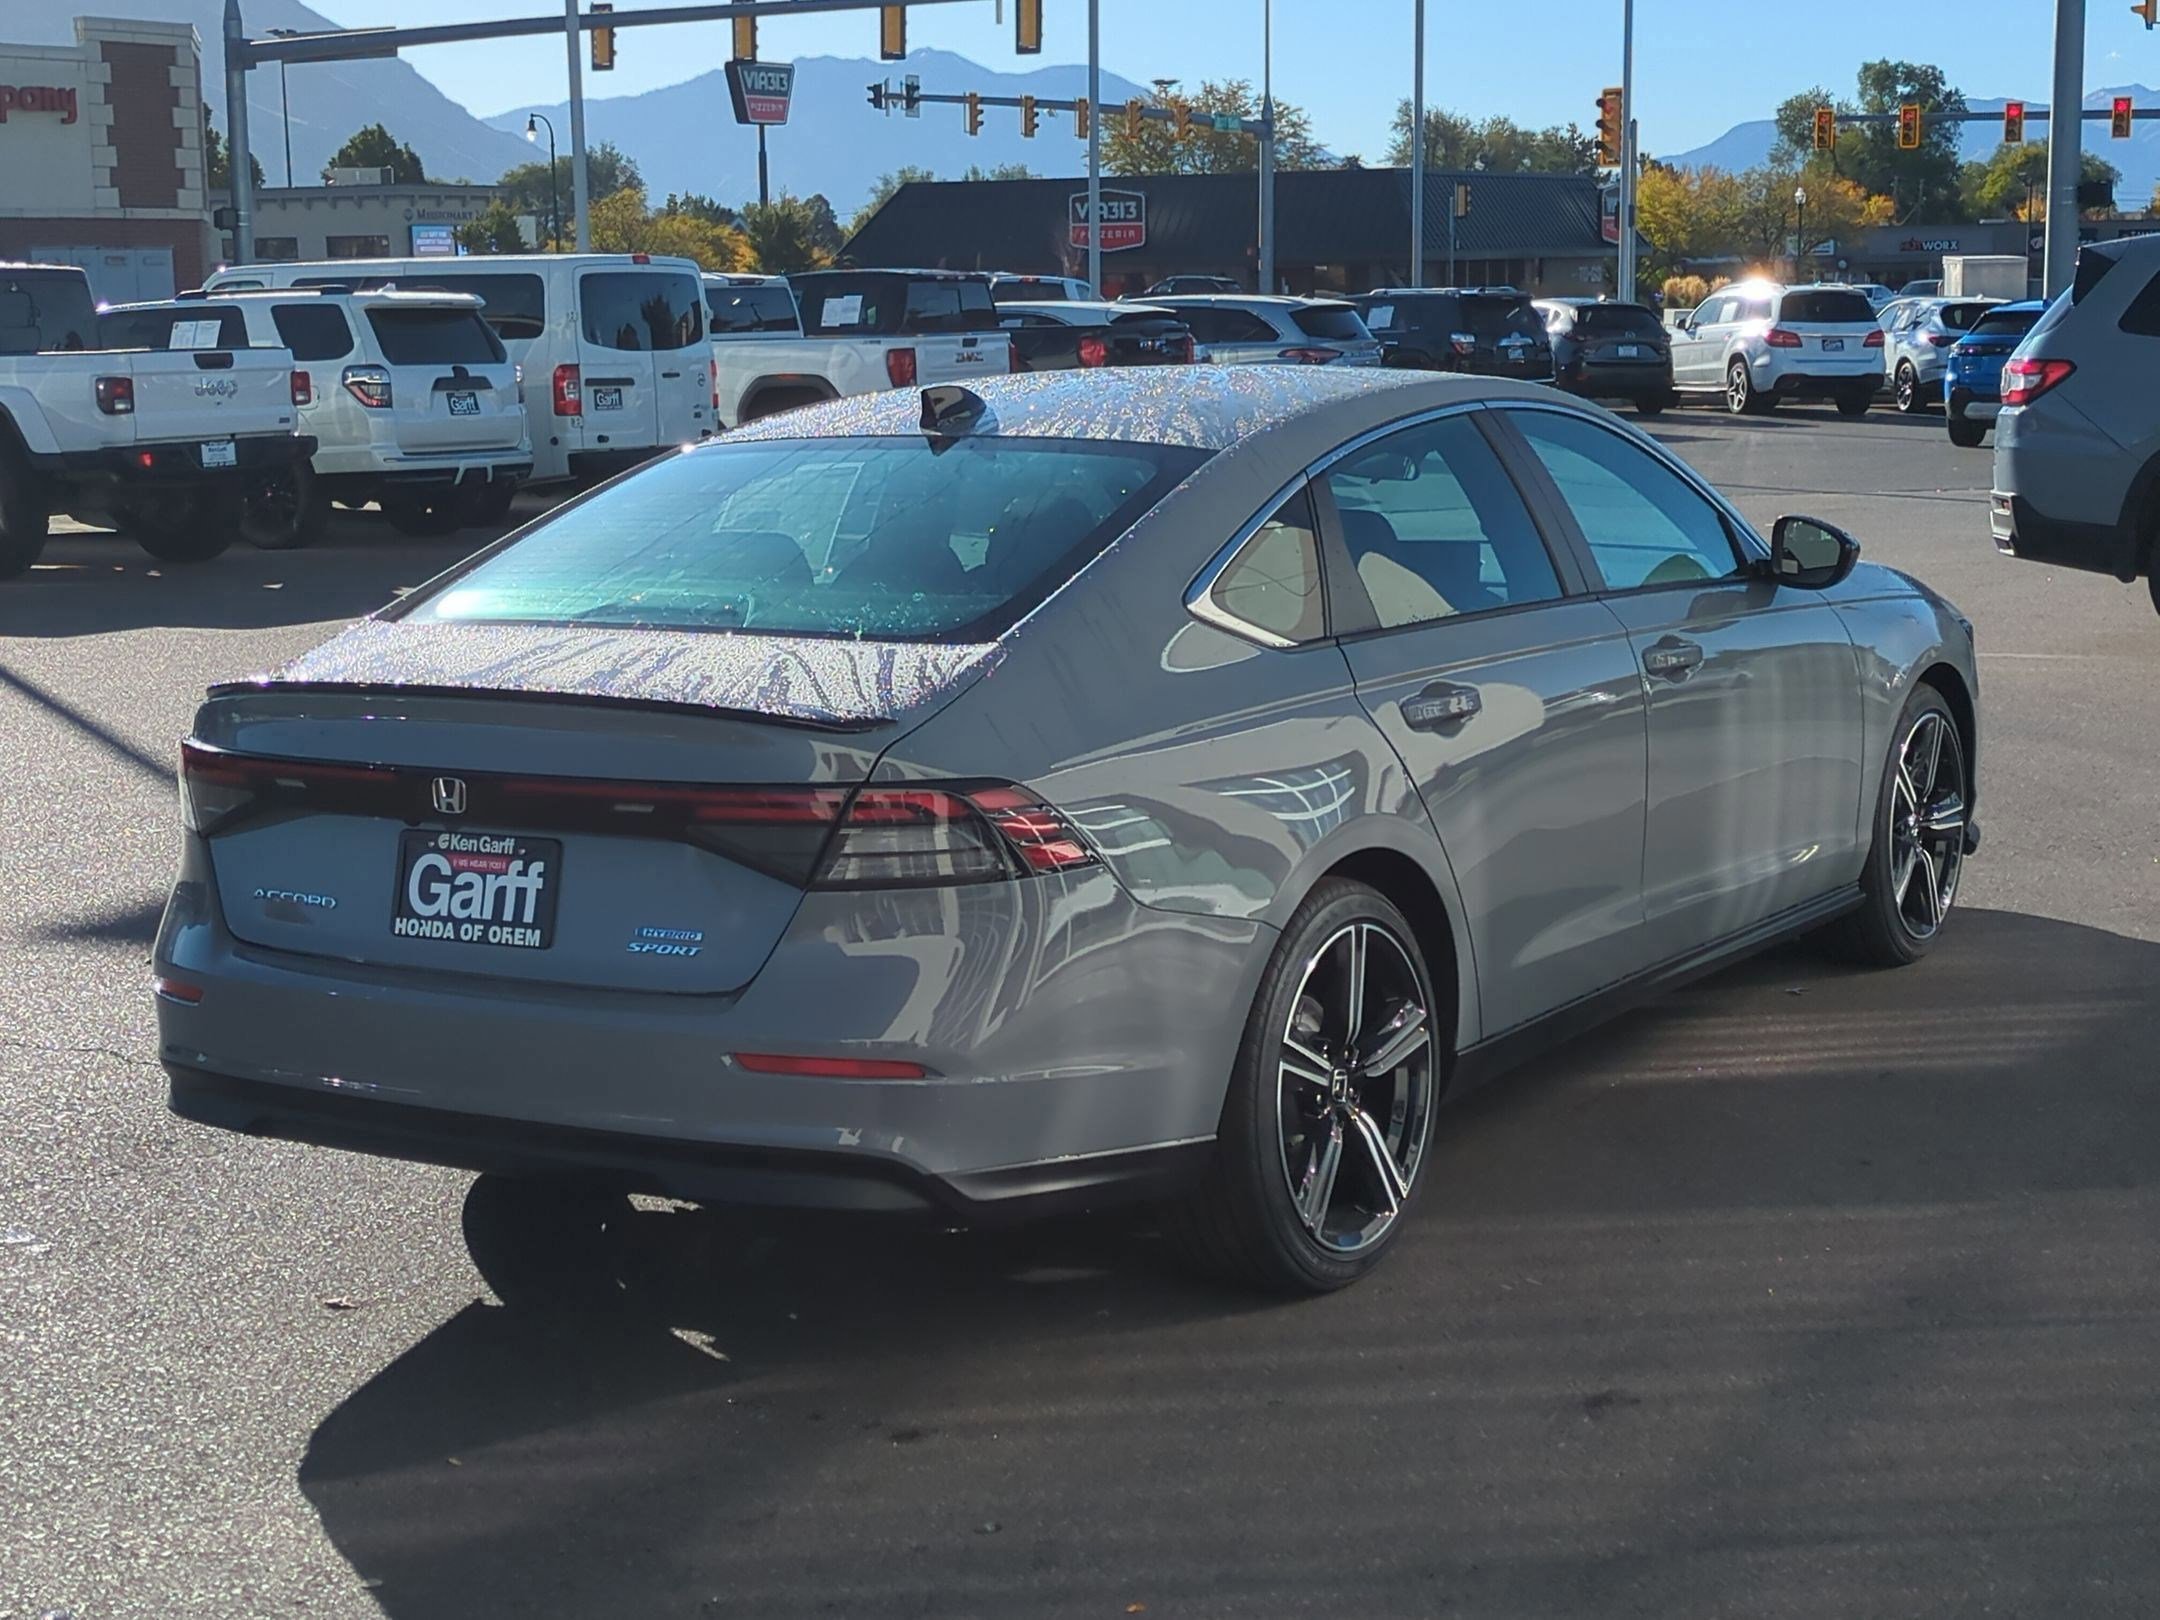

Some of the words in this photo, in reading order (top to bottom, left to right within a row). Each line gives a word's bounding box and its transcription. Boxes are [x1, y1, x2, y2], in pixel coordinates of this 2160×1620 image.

[1075, 201, 1137, 219] VA313
[1079, 229, 1136, 240] PZERIA
[450, 833, 478, 852] Ken
[479, 835, 516, 855] Garff
[408, 853, 545, 923] Garff
[394, 917, 455, 940] HONDA
[459, 923, 485, 942] OF
[487, 926, 542, 947] OREM
[626, 941, 704, 956] SPORT
